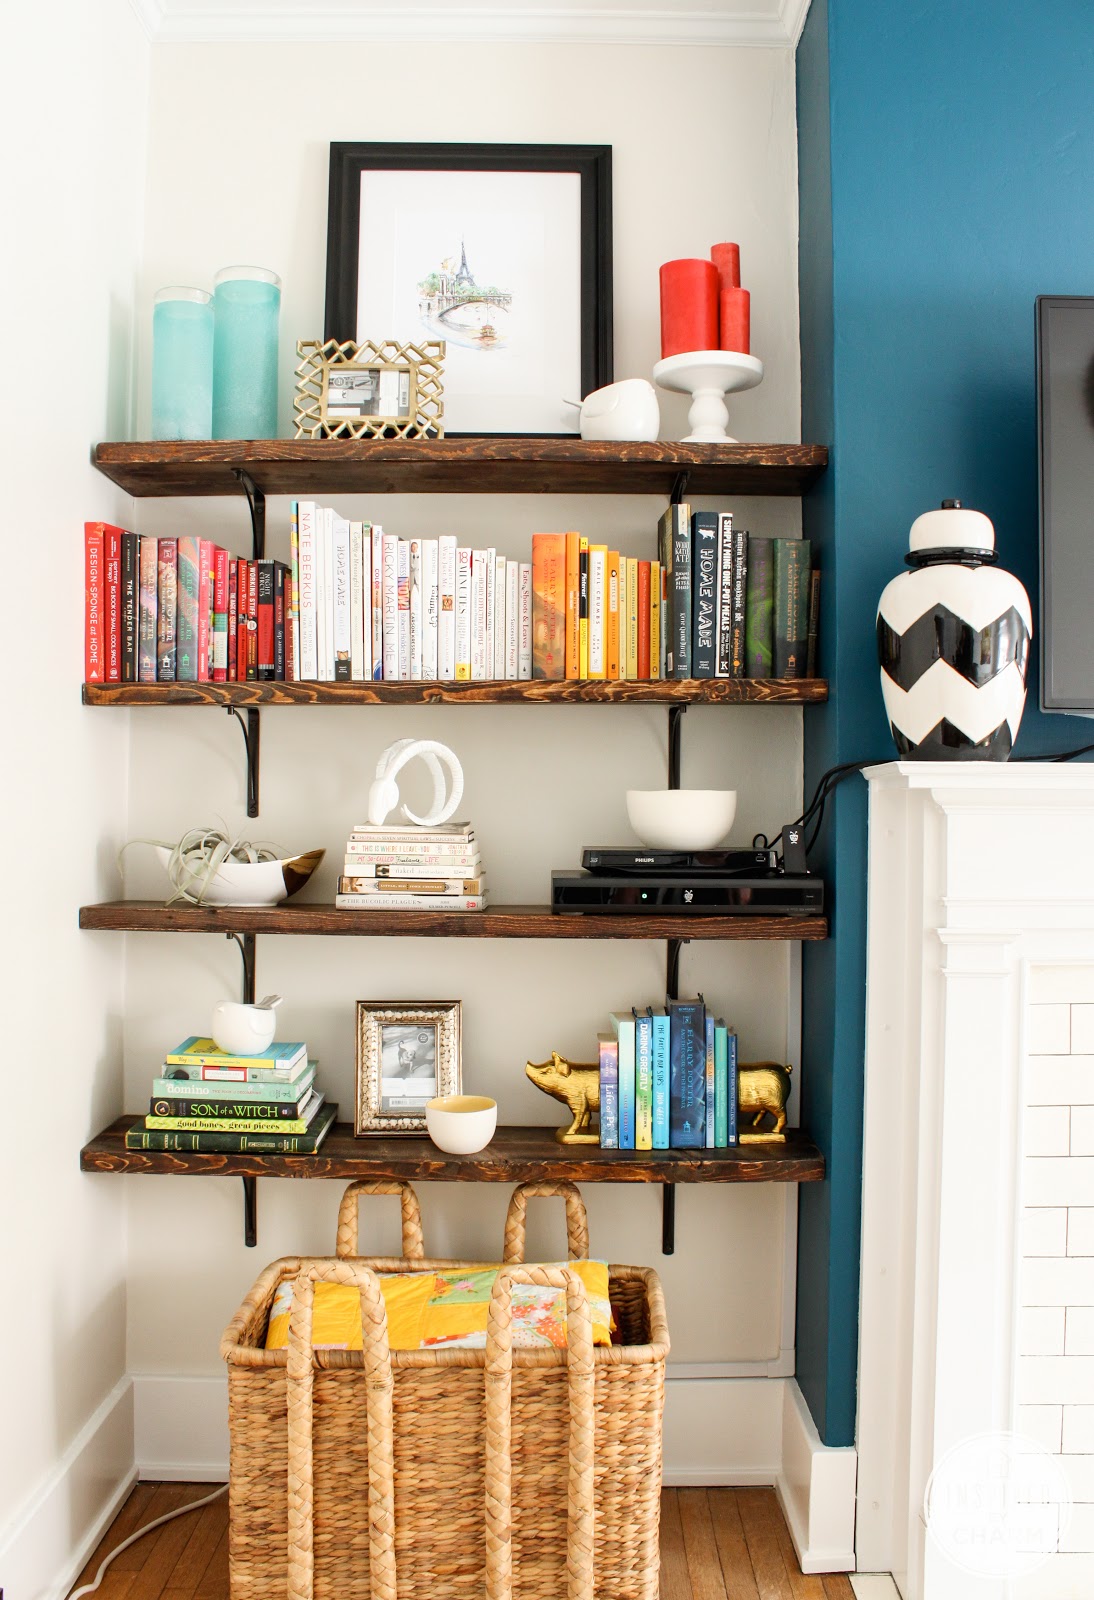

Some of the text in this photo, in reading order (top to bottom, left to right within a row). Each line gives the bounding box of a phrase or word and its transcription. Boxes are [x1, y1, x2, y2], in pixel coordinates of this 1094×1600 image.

[302, 513, 312, 608] NATE BERKUS
[458, 552, 468, 563] 18
[699, 548, 713, 598] HOME
[722, 519, 731, 630] SIMPLY MING ONE-POT MEALS
[443, 577, 447, 588] Me
[385, 542, 395, 661] RICKY MARTIN ME
[90, 626, 98, 636] at
[698, 600, 712, 647] MADE
[90, 637, 98, 664] HOME
[167, 1084, 209, 1094] domino
[605, 1084, 614, 1104] Life
[190, 1104, 218, 1116] SON
[220, 1105, 228, 1116] of
[233, 1106, 278, 1117] WITCH
[177, 1120, 197, 1128] good
[606, 1116, 614, 1126] Pi
